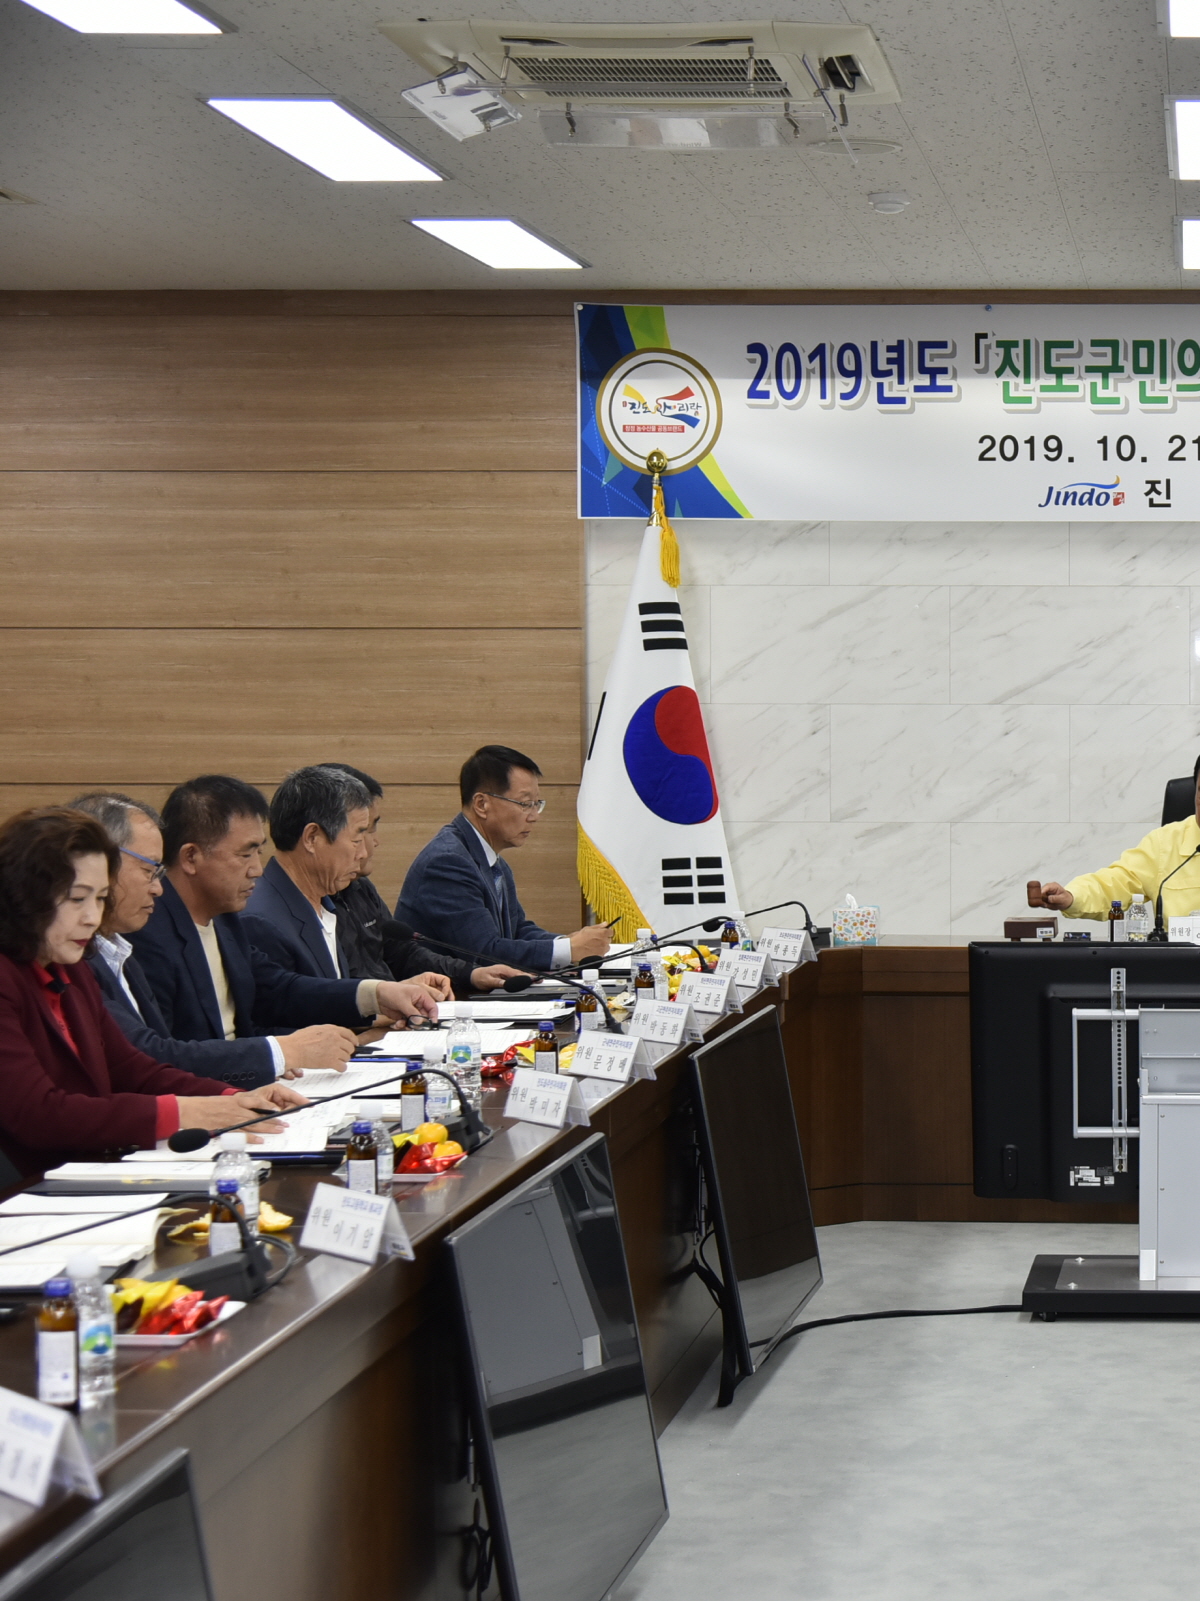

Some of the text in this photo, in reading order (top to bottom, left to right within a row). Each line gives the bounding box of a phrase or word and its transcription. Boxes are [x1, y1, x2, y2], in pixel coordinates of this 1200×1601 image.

[746, 341, 955, 406] 2019년도
[977, 434, 1076, 464] 2019.
[1097, 434, 1149, 464] 10.
[1038, 486, 1110, 508] Jindo
[576, 1046, 593, 1060] 위원
[511, 1086, 528, 1102] 위원
